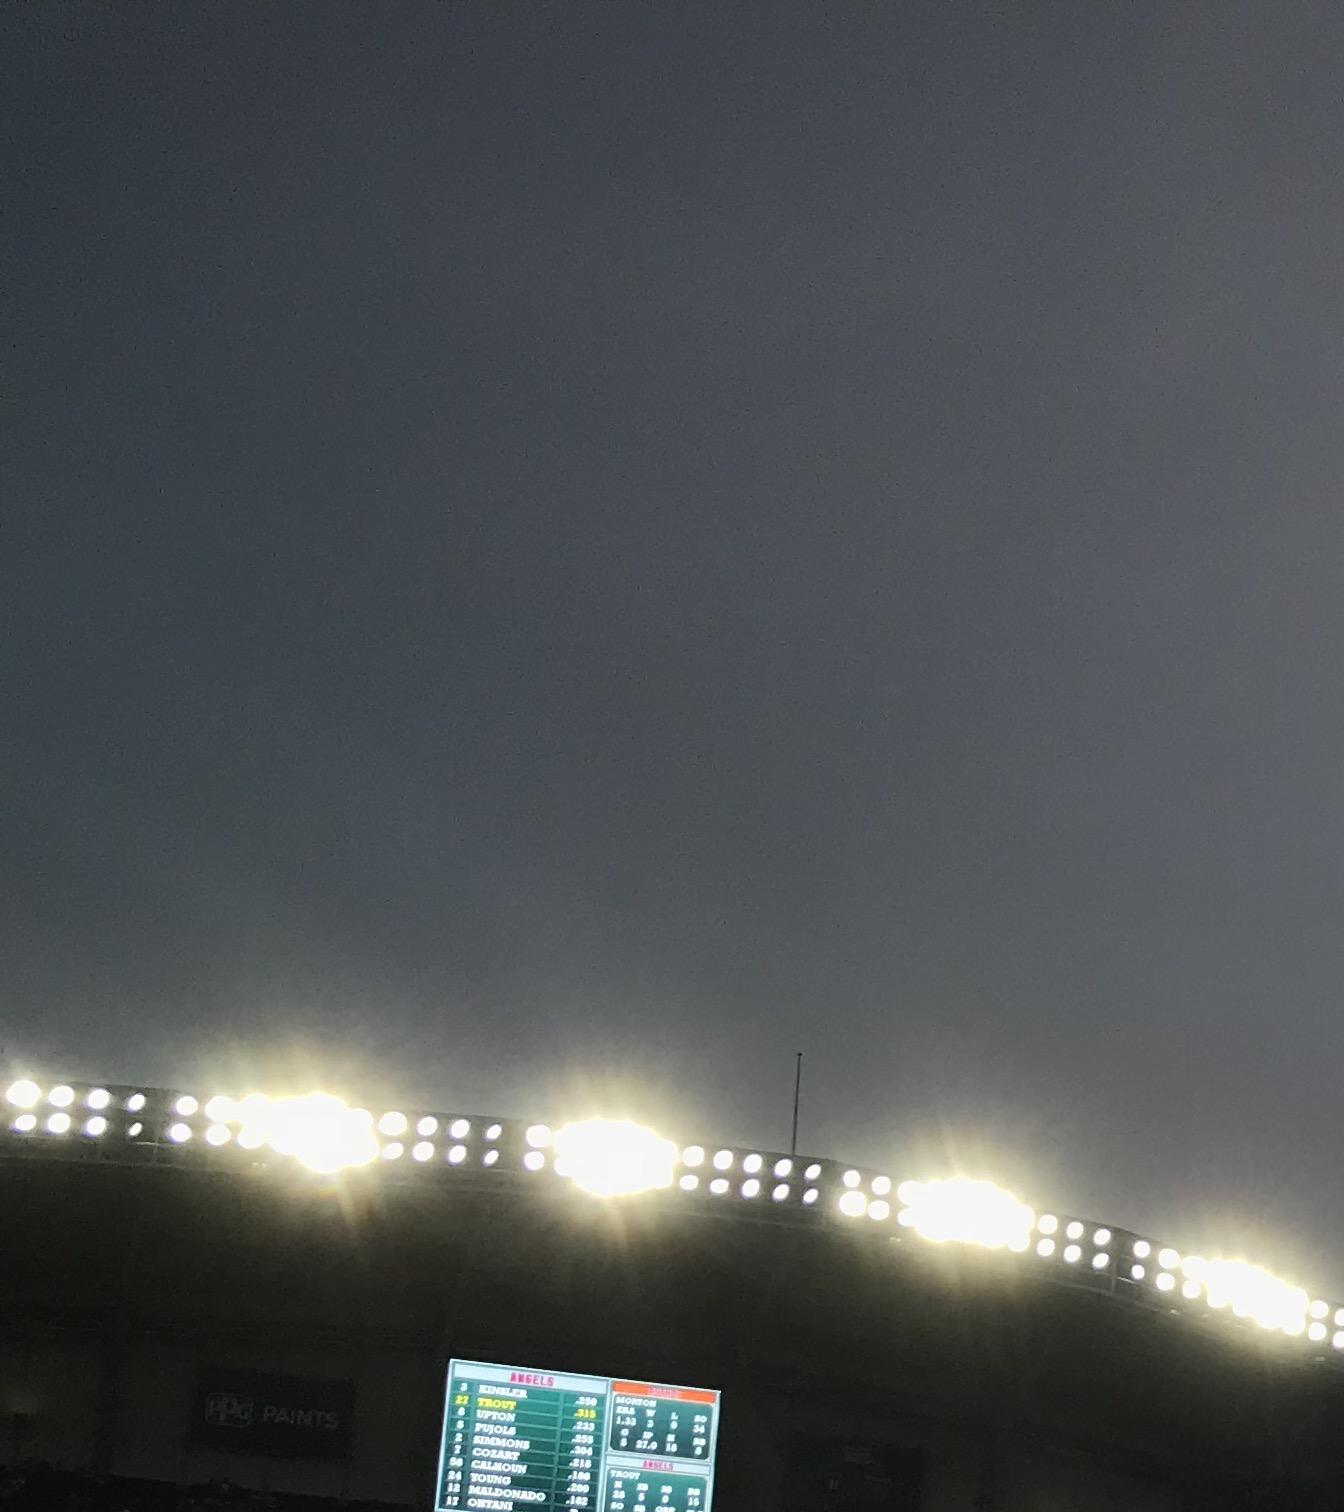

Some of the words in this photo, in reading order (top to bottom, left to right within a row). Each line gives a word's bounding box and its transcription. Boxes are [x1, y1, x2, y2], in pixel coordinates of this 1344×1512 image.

[510, 1372, 554, 1387] ANGELS
[478, 1384, 528, 1398] KINSLER
[476, 1397, 517, 1410] TROUT
[263, 1406, 338, 1429] PAINTS
[476, 1409, 516, 1422] UPTON
[474, 1422, 516, 1436] PUJOLS
[473, 1435, 530, 1450] SIMMONS
[472, 1447, 520, 1461] COZART
[471, 1459, 528, 1474] CALHOUN
[470, 1472, 512, 1486] YOUNG
[468, 1485, 547, 1502] MALDONADO
[467, 1498, 513, 1511] OHTANI
